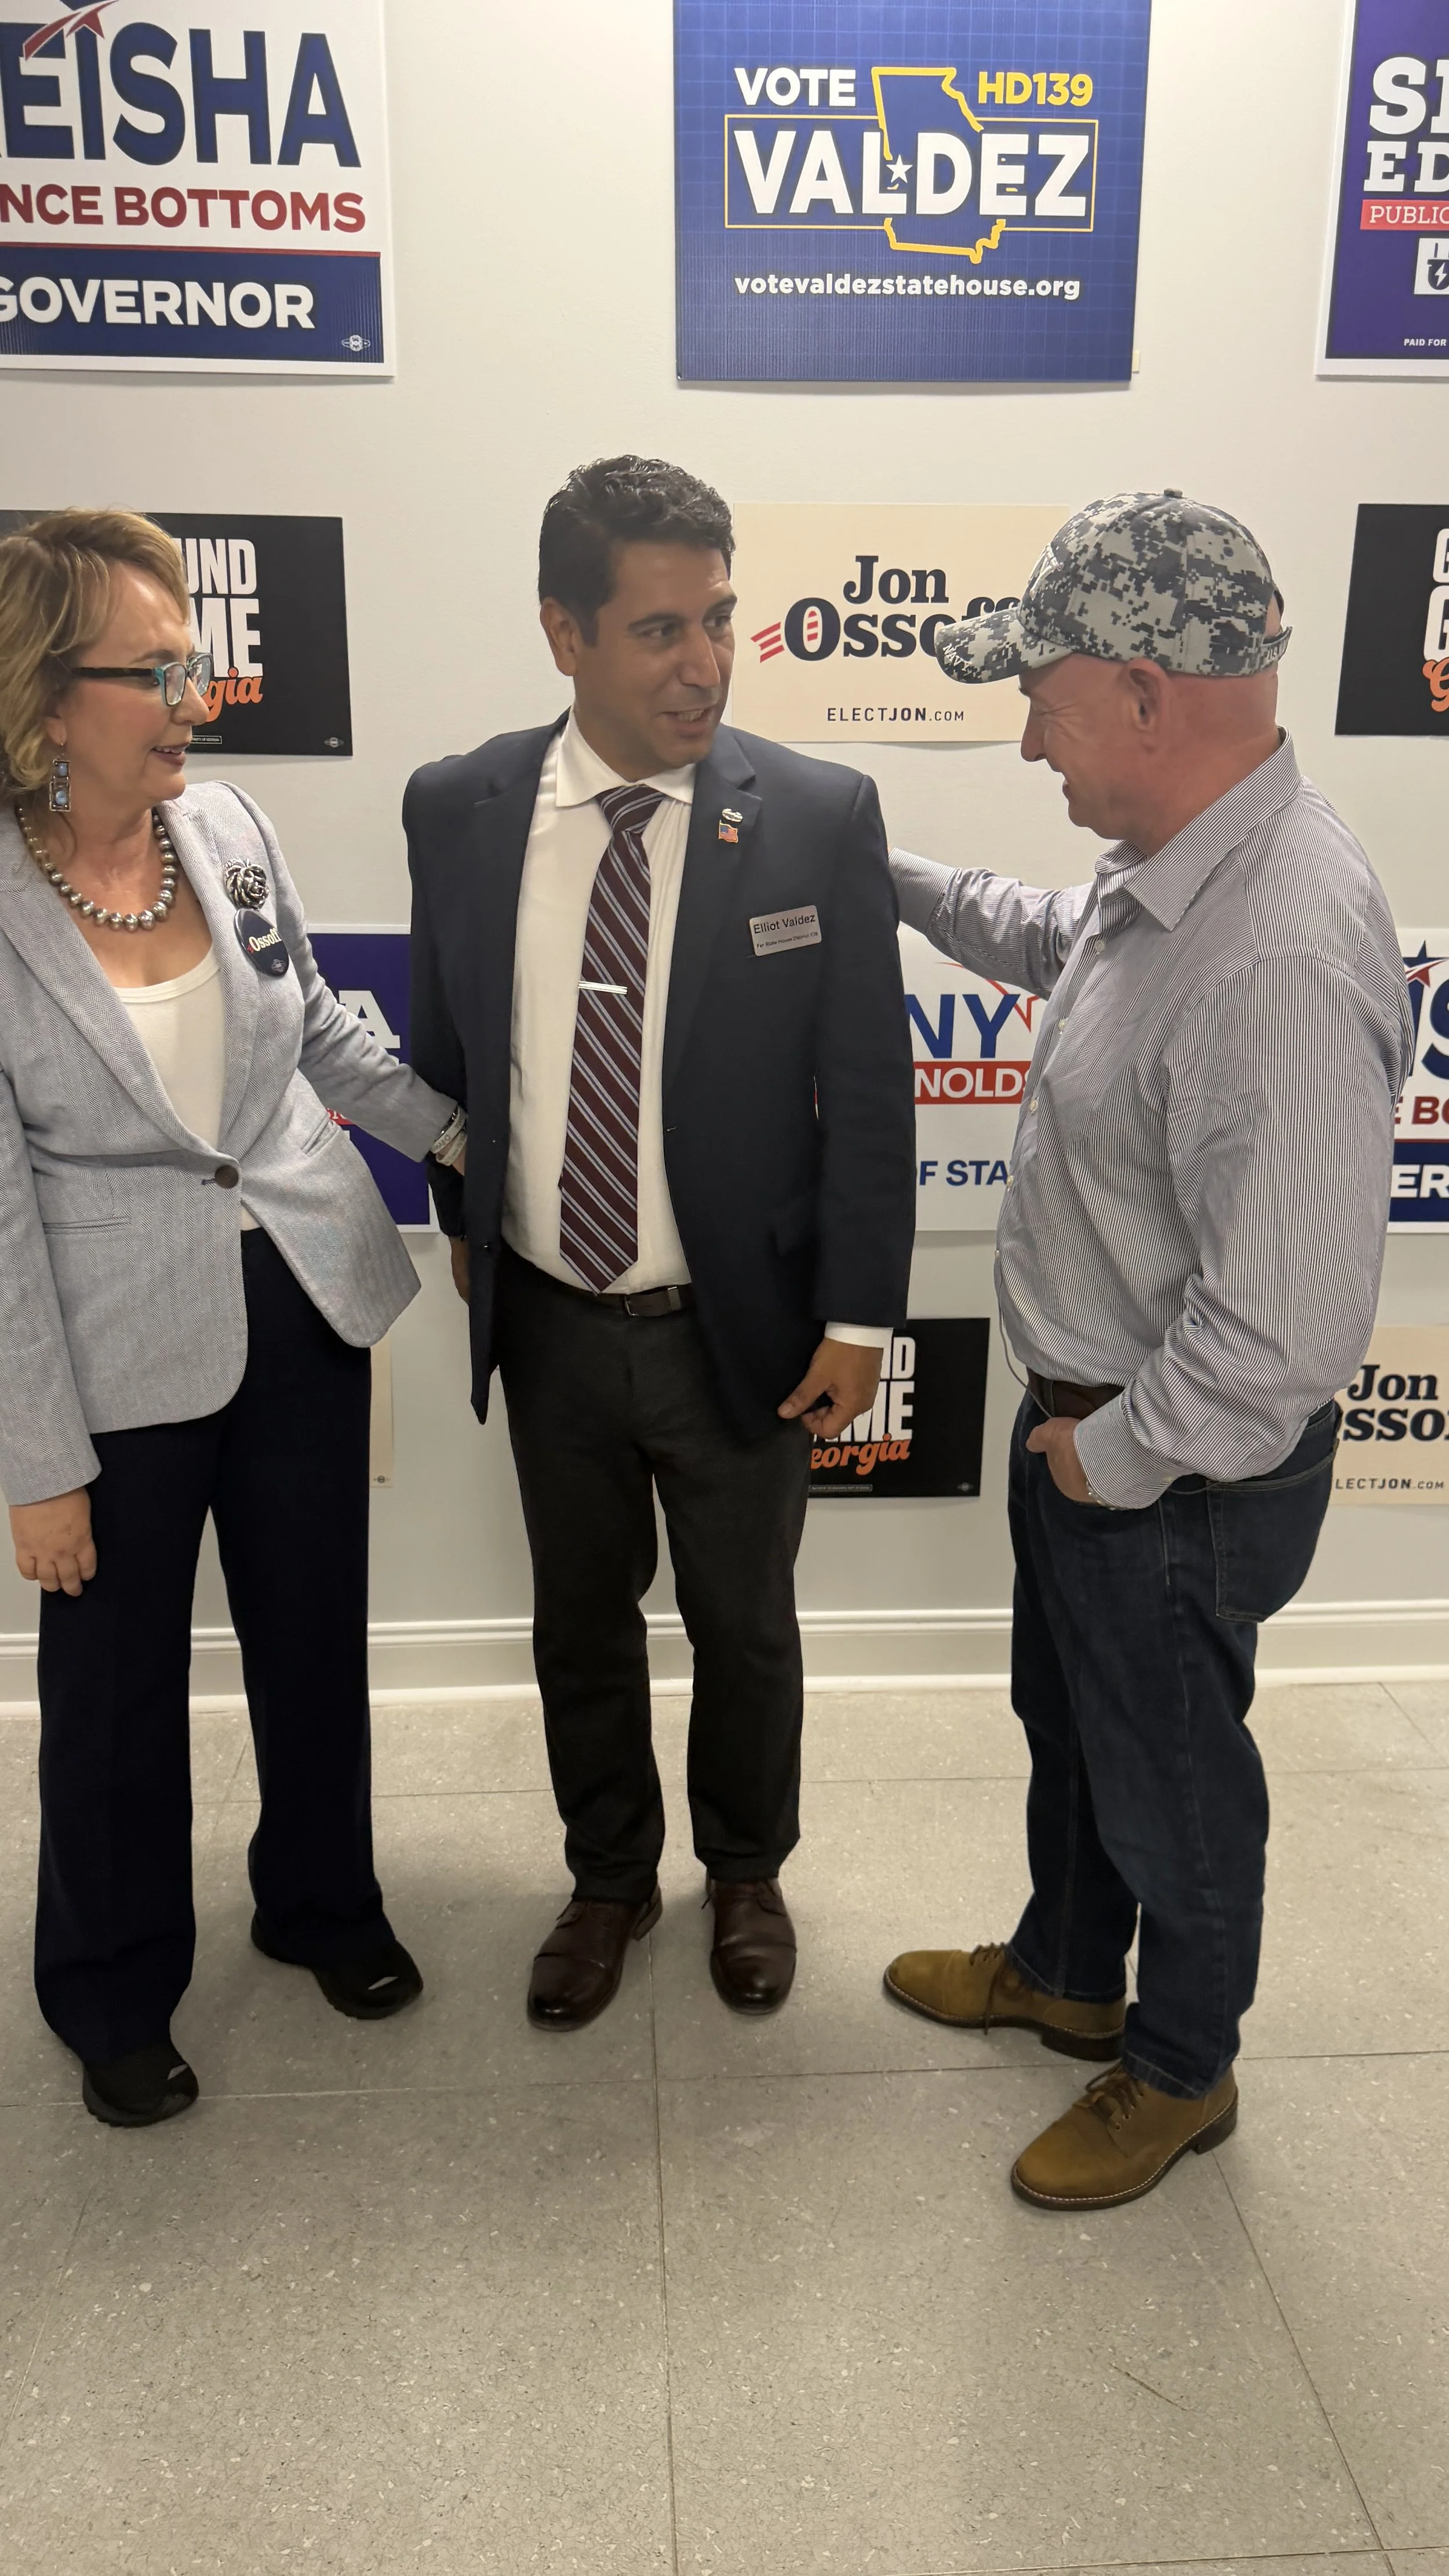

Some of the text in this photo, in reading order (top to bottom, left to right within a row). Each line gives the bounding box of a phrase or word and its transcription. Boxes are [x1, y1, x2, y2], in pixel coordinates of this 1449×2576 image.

[0, 22, 362, 168] EISHA
[734, 67, 1093, 107] VOTE HD139
[734, 130, 1089, 217] VALDEZ
[0, 184, 366, 233] NCE BOTTOMS
[1369, 205, 1449, 224] PUBLIC
[734, 274, 1080, 300] votevaldezstatehouse.org
[1404, 339, 1447, 347] PAID FOR
[843, 555, 949, 604] Jon
[827, 707, 964, 722] ELECTJON.COM
[249, 927, 282, 952] Ossoff
[753, 915, 815, 934] Elliot Valdez
[915, 1068, 1029, 1098] NOLD
[1347, 1364, 1439, 1401] Jon
[1343, 1408, 1449, 1442] sso
